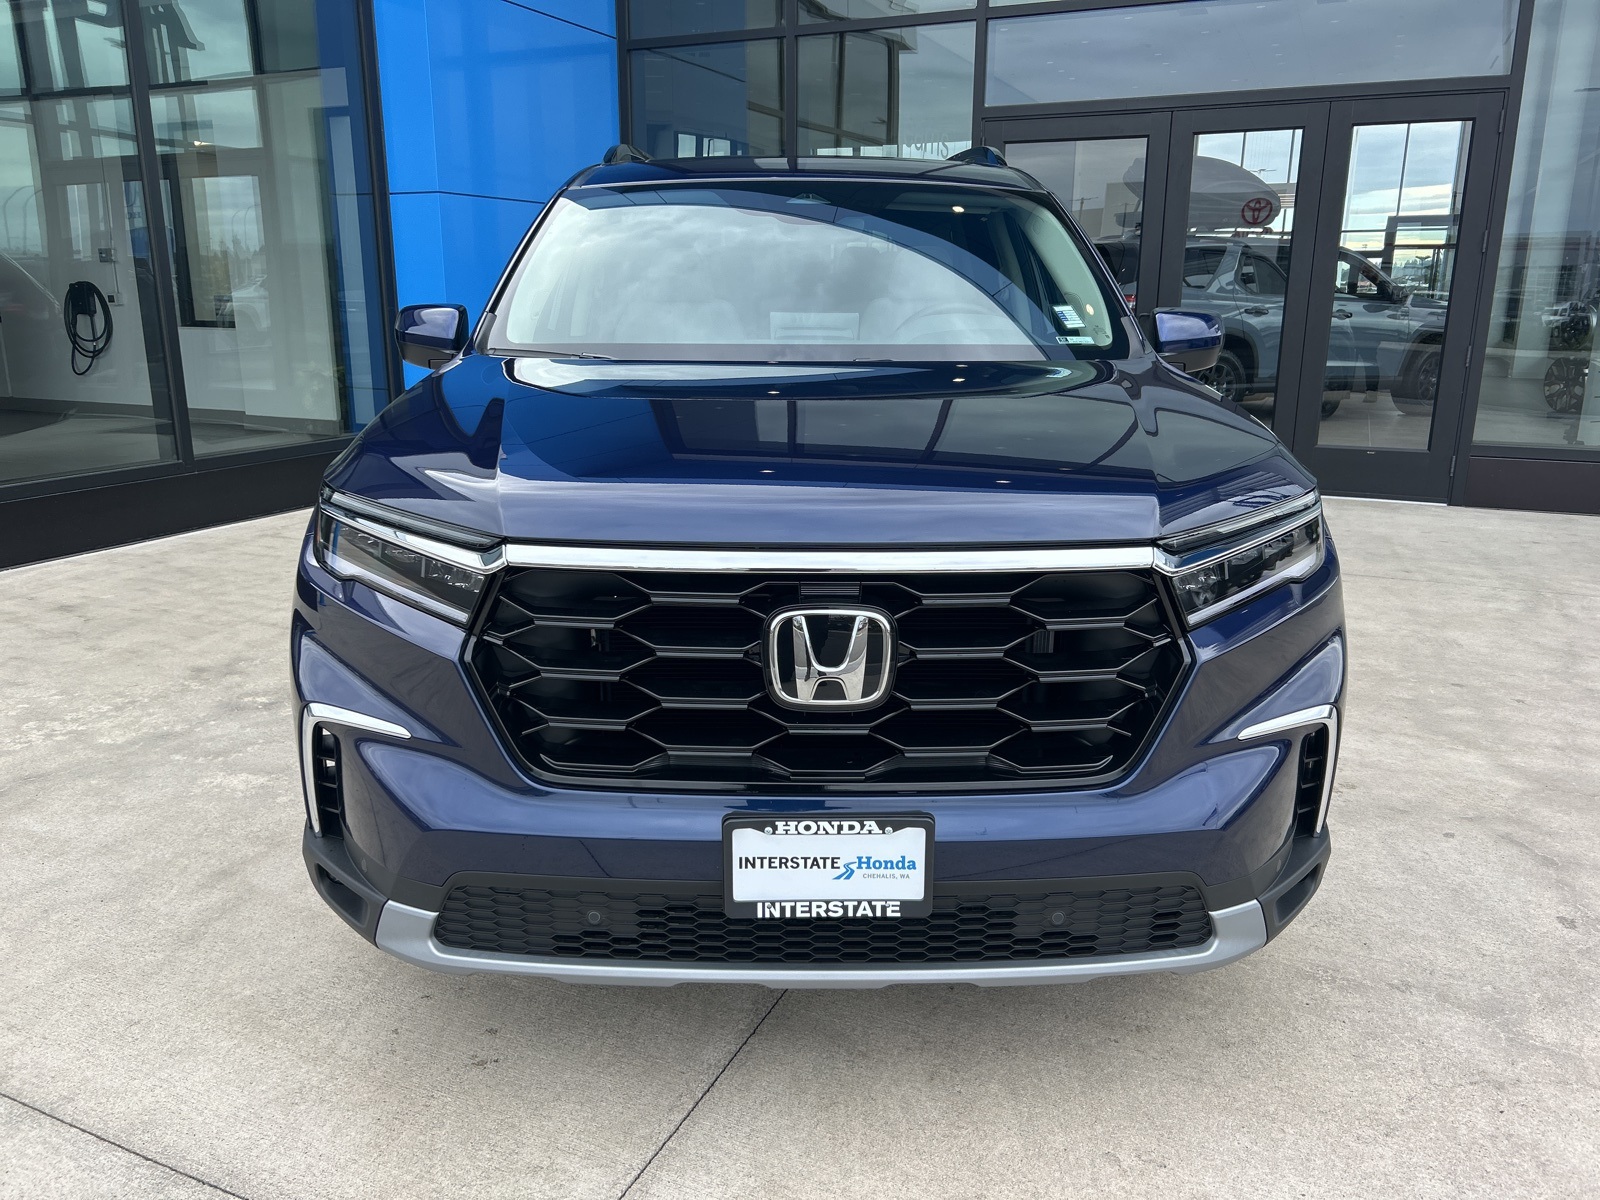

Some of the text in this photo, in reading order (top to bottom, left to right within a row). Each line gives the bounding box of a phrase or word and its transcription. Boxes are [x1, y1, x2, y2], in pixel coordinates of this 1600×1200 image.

[775, 820, 883, 835] HONDA
[738, 855, 917, 870] INTERSTATE Honda
[756, 900, 901, 918] INTERSTATE
